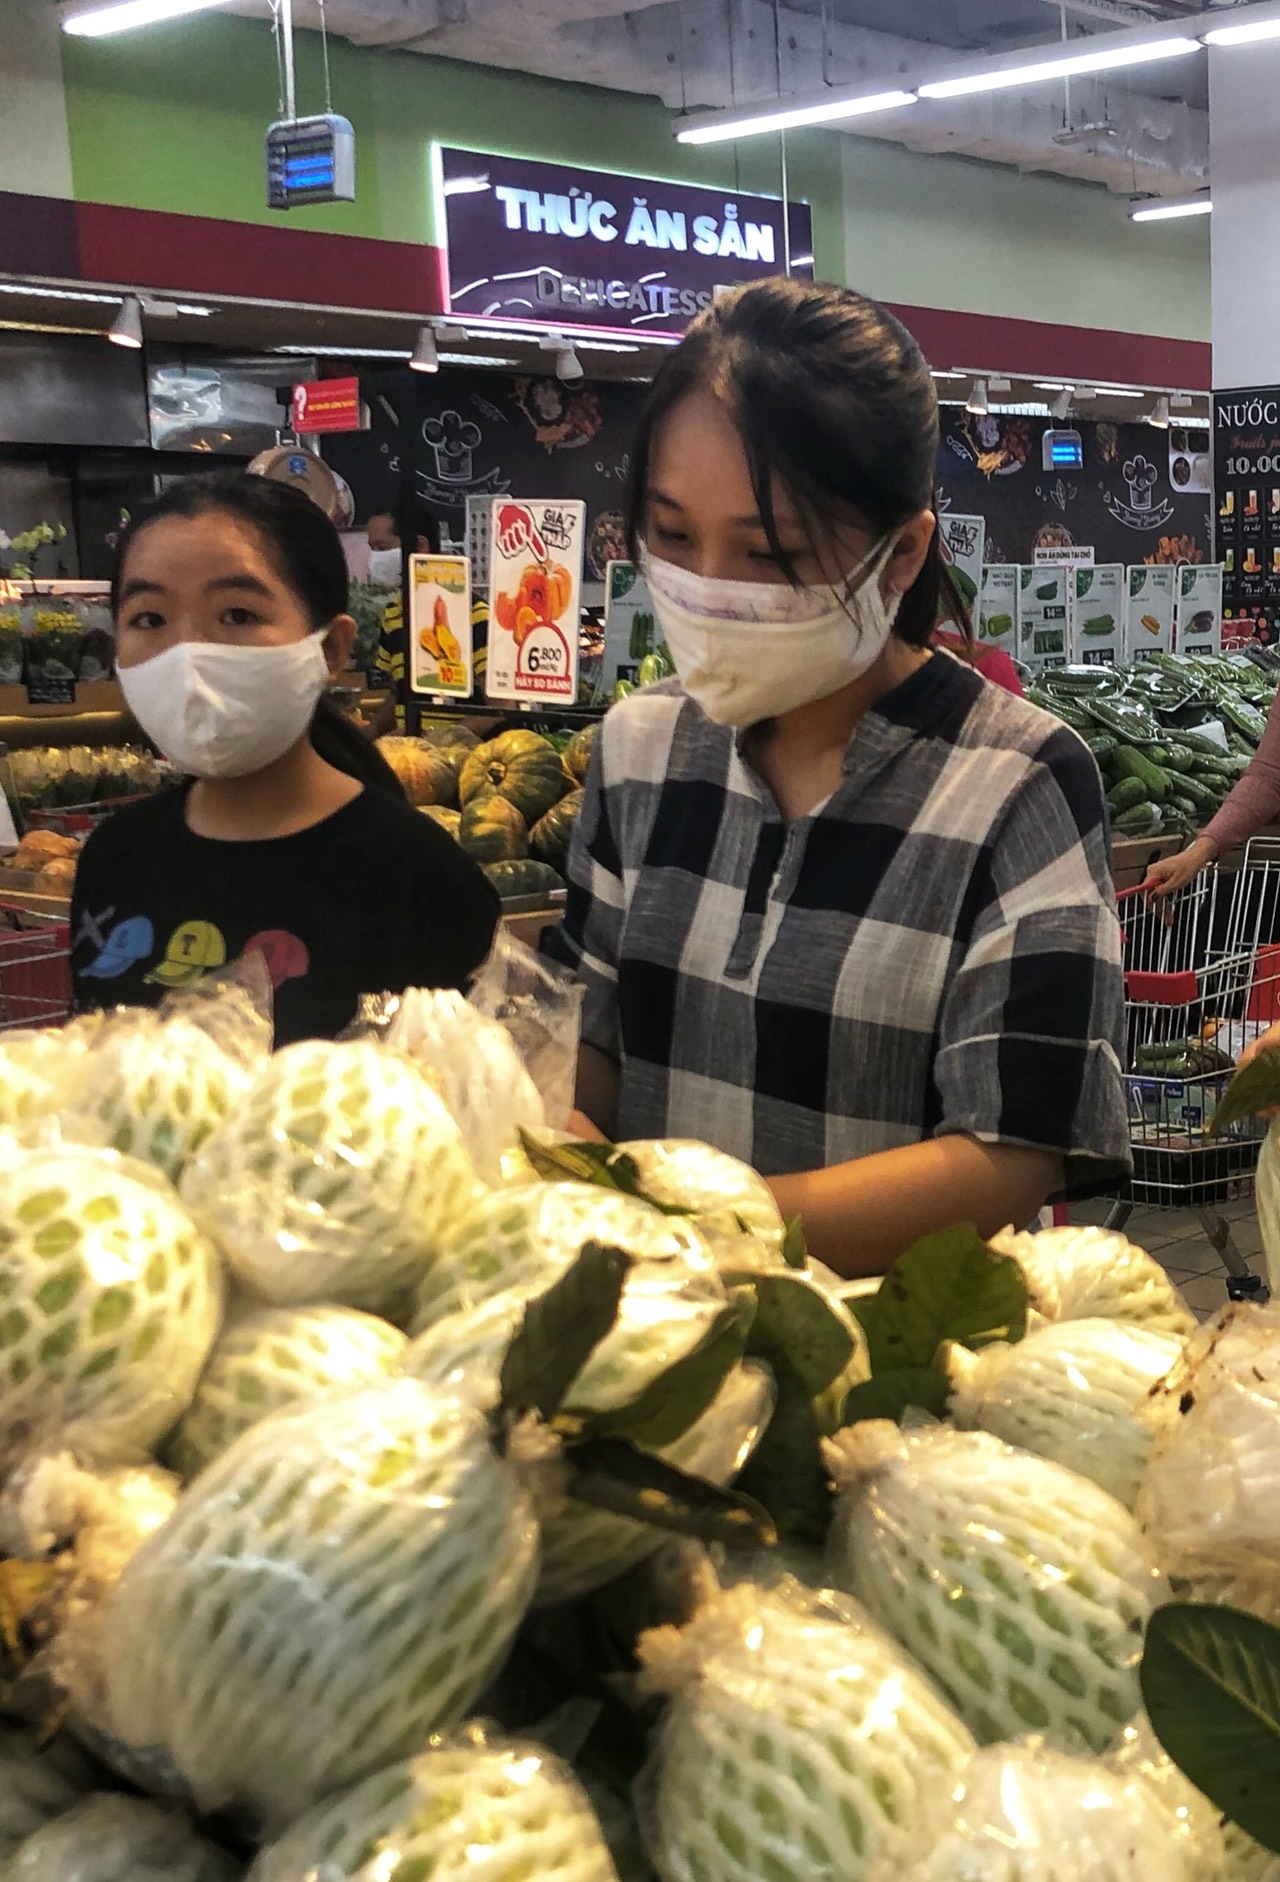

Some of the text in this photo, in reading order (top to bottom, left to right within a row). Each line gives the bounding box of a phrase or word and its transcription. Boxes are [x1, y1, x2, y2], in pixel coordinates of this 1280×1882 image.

[496, 185, 775, 263] THỨC ĂN SẴN
[1217, 397, 1278, 428] NƯỚC
[543, 506, 564, 525] GIÁ
[528, 647, 539, 671] 6
